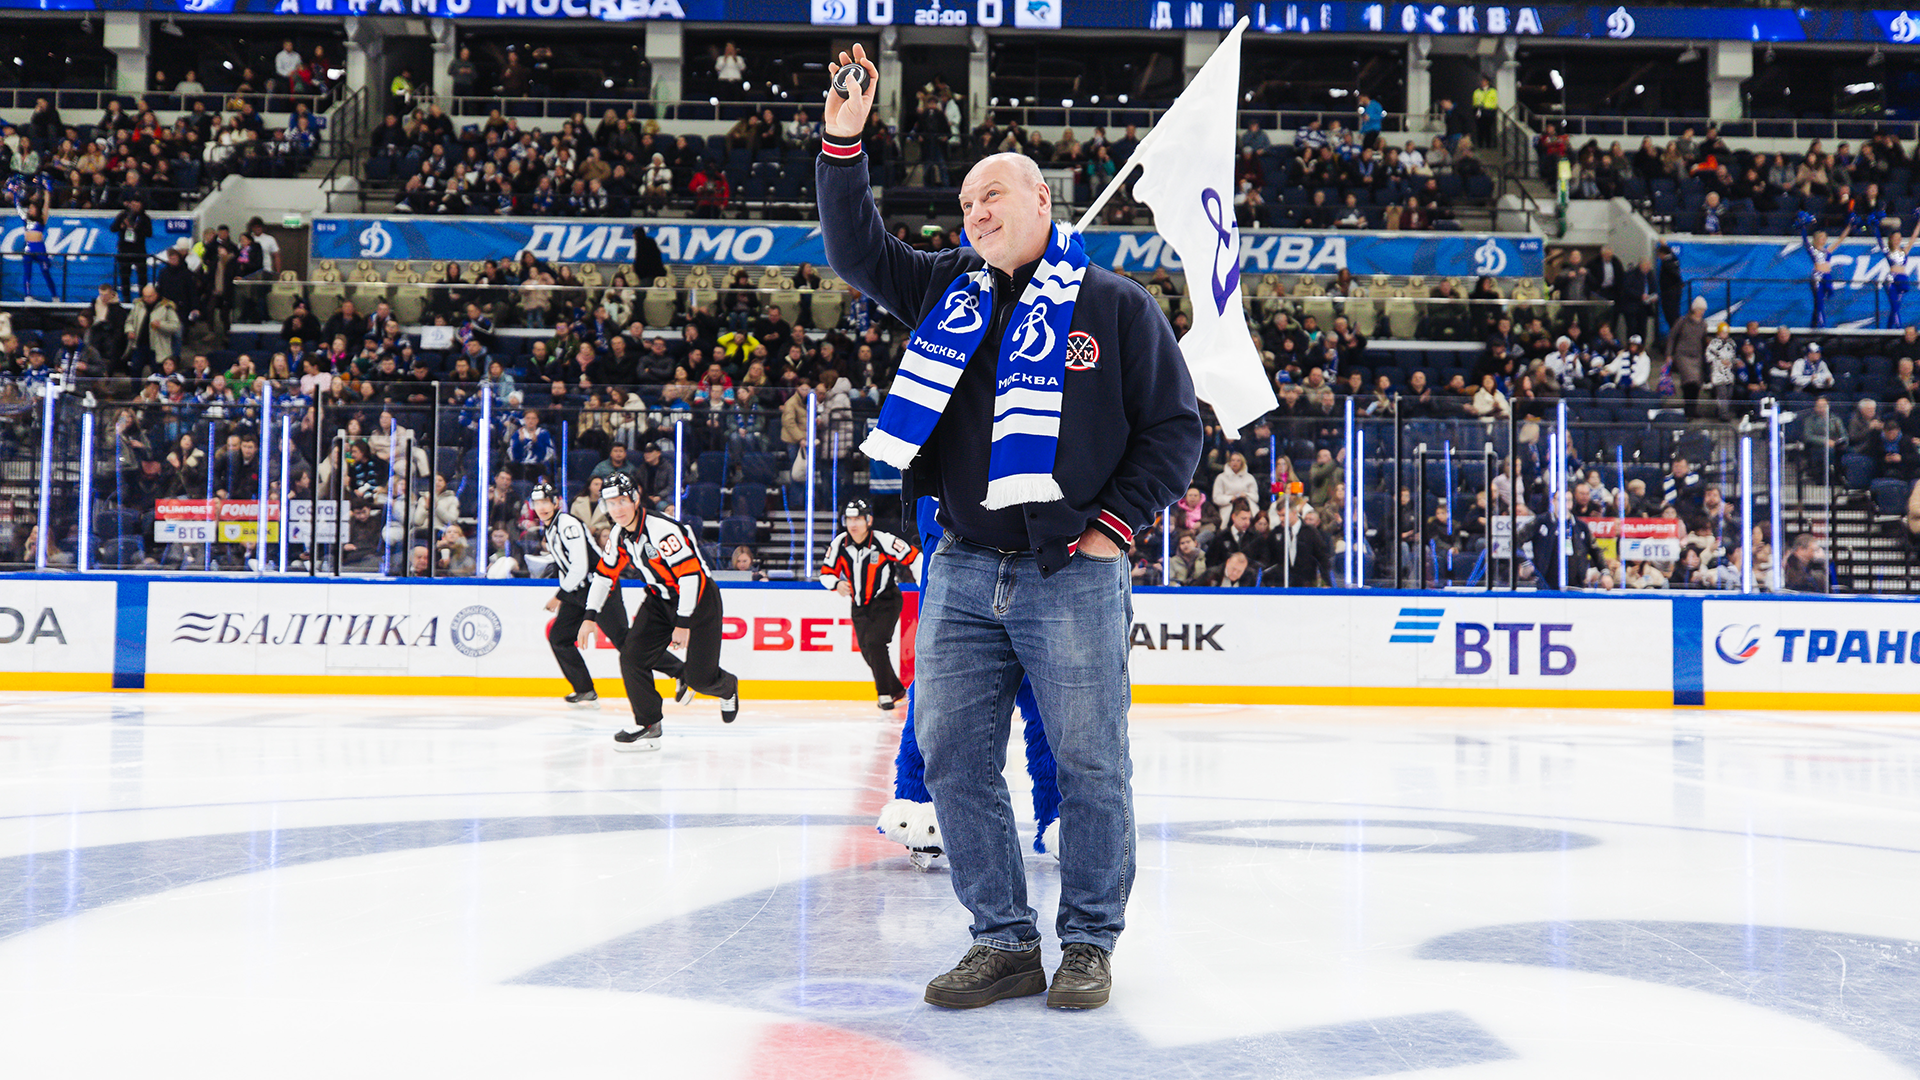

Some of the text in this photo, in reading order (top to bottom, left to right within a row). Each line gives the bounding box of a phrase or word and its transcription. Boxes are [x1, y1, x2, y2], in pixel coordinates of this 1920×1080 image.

[915, 9, 968, 26] 20:00
[514, 224, 775, 263] ДИНАМО
[1112, 234, 1348, 272] МКВА
[913, 335, 967, 363] МОСКВА
[998, 372, 1059, 389] МОСКВА
[221, 503, 279, 517] FONBT
[178, 526, 206, 539] ВТБ
[659, 533, 682, 557] 38
[1643, 544, 1670, 557] ВТБ
[214, 613, 439, 647] БАЛТИКА
[1130, 623, 1225, 651] АНК
[1454, 623, 1576, 676] ВТБ
